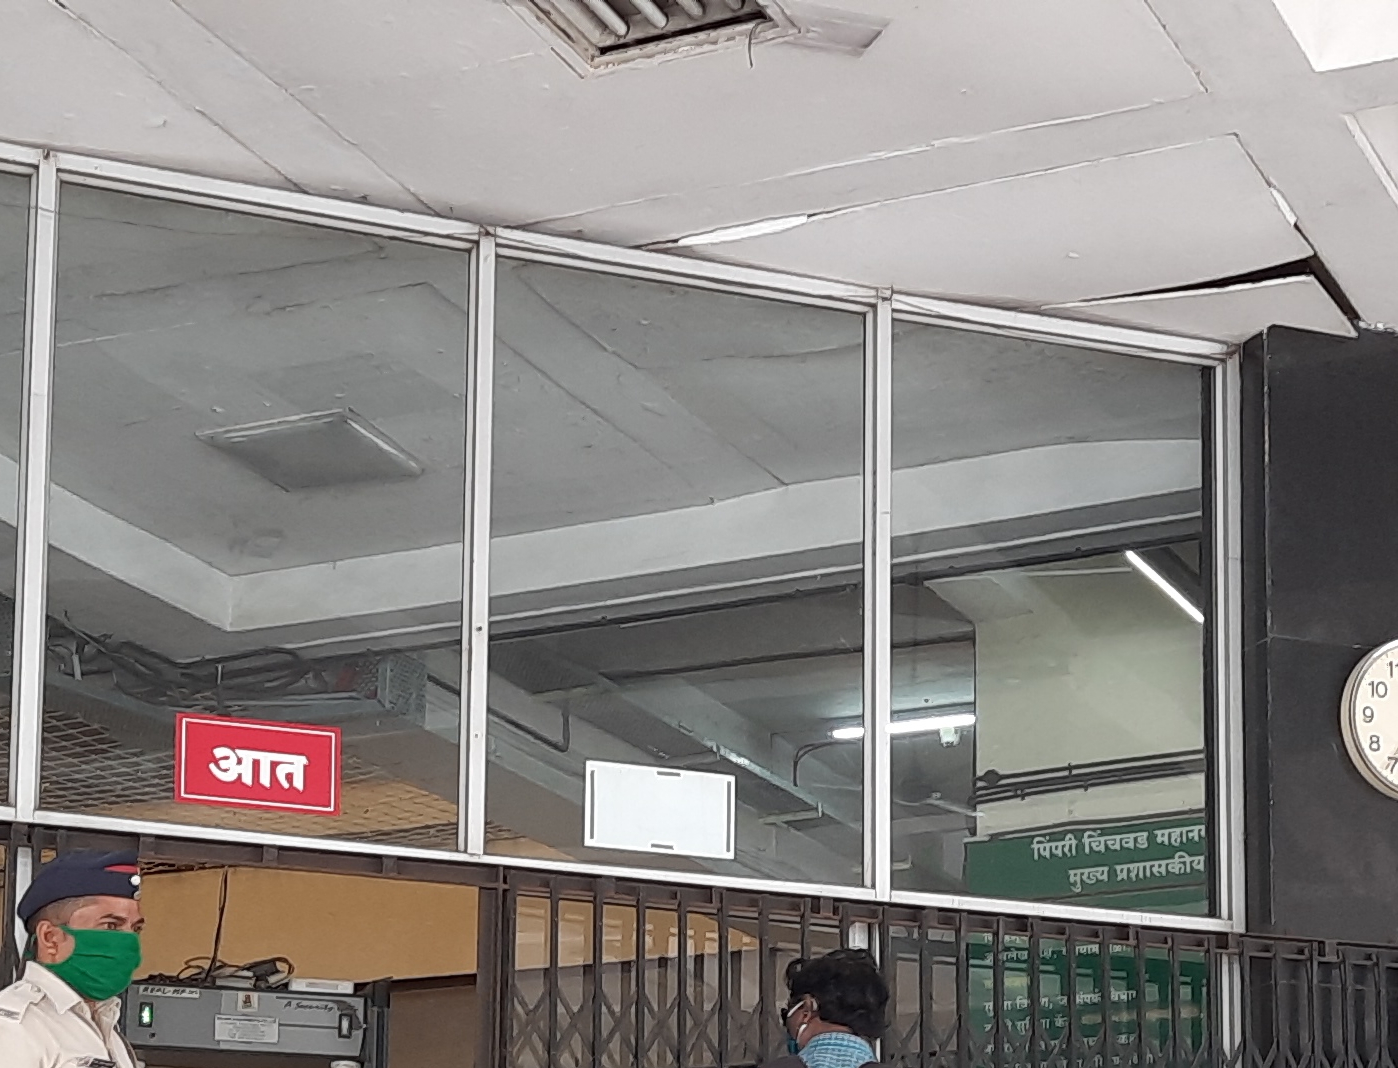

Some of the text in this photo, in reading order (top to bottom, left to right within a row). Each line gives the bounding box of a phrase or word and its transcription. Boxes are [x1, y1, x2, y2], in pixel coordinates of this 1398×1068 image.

[1368, 680, 1388, 698] 10
[1362, 706, 1374, 723] 9
[1369, 735, 1381, 752] 8
[208, 746, 309, 793] आत
[1387, 756, 1398, 774] 7
[1032, 833, 1077, 861] पिंपरी
[1082, 829, 1150, 855] चिंचवड
[1067, 852, 1205, 892] मुख्य प्रशासकीय
